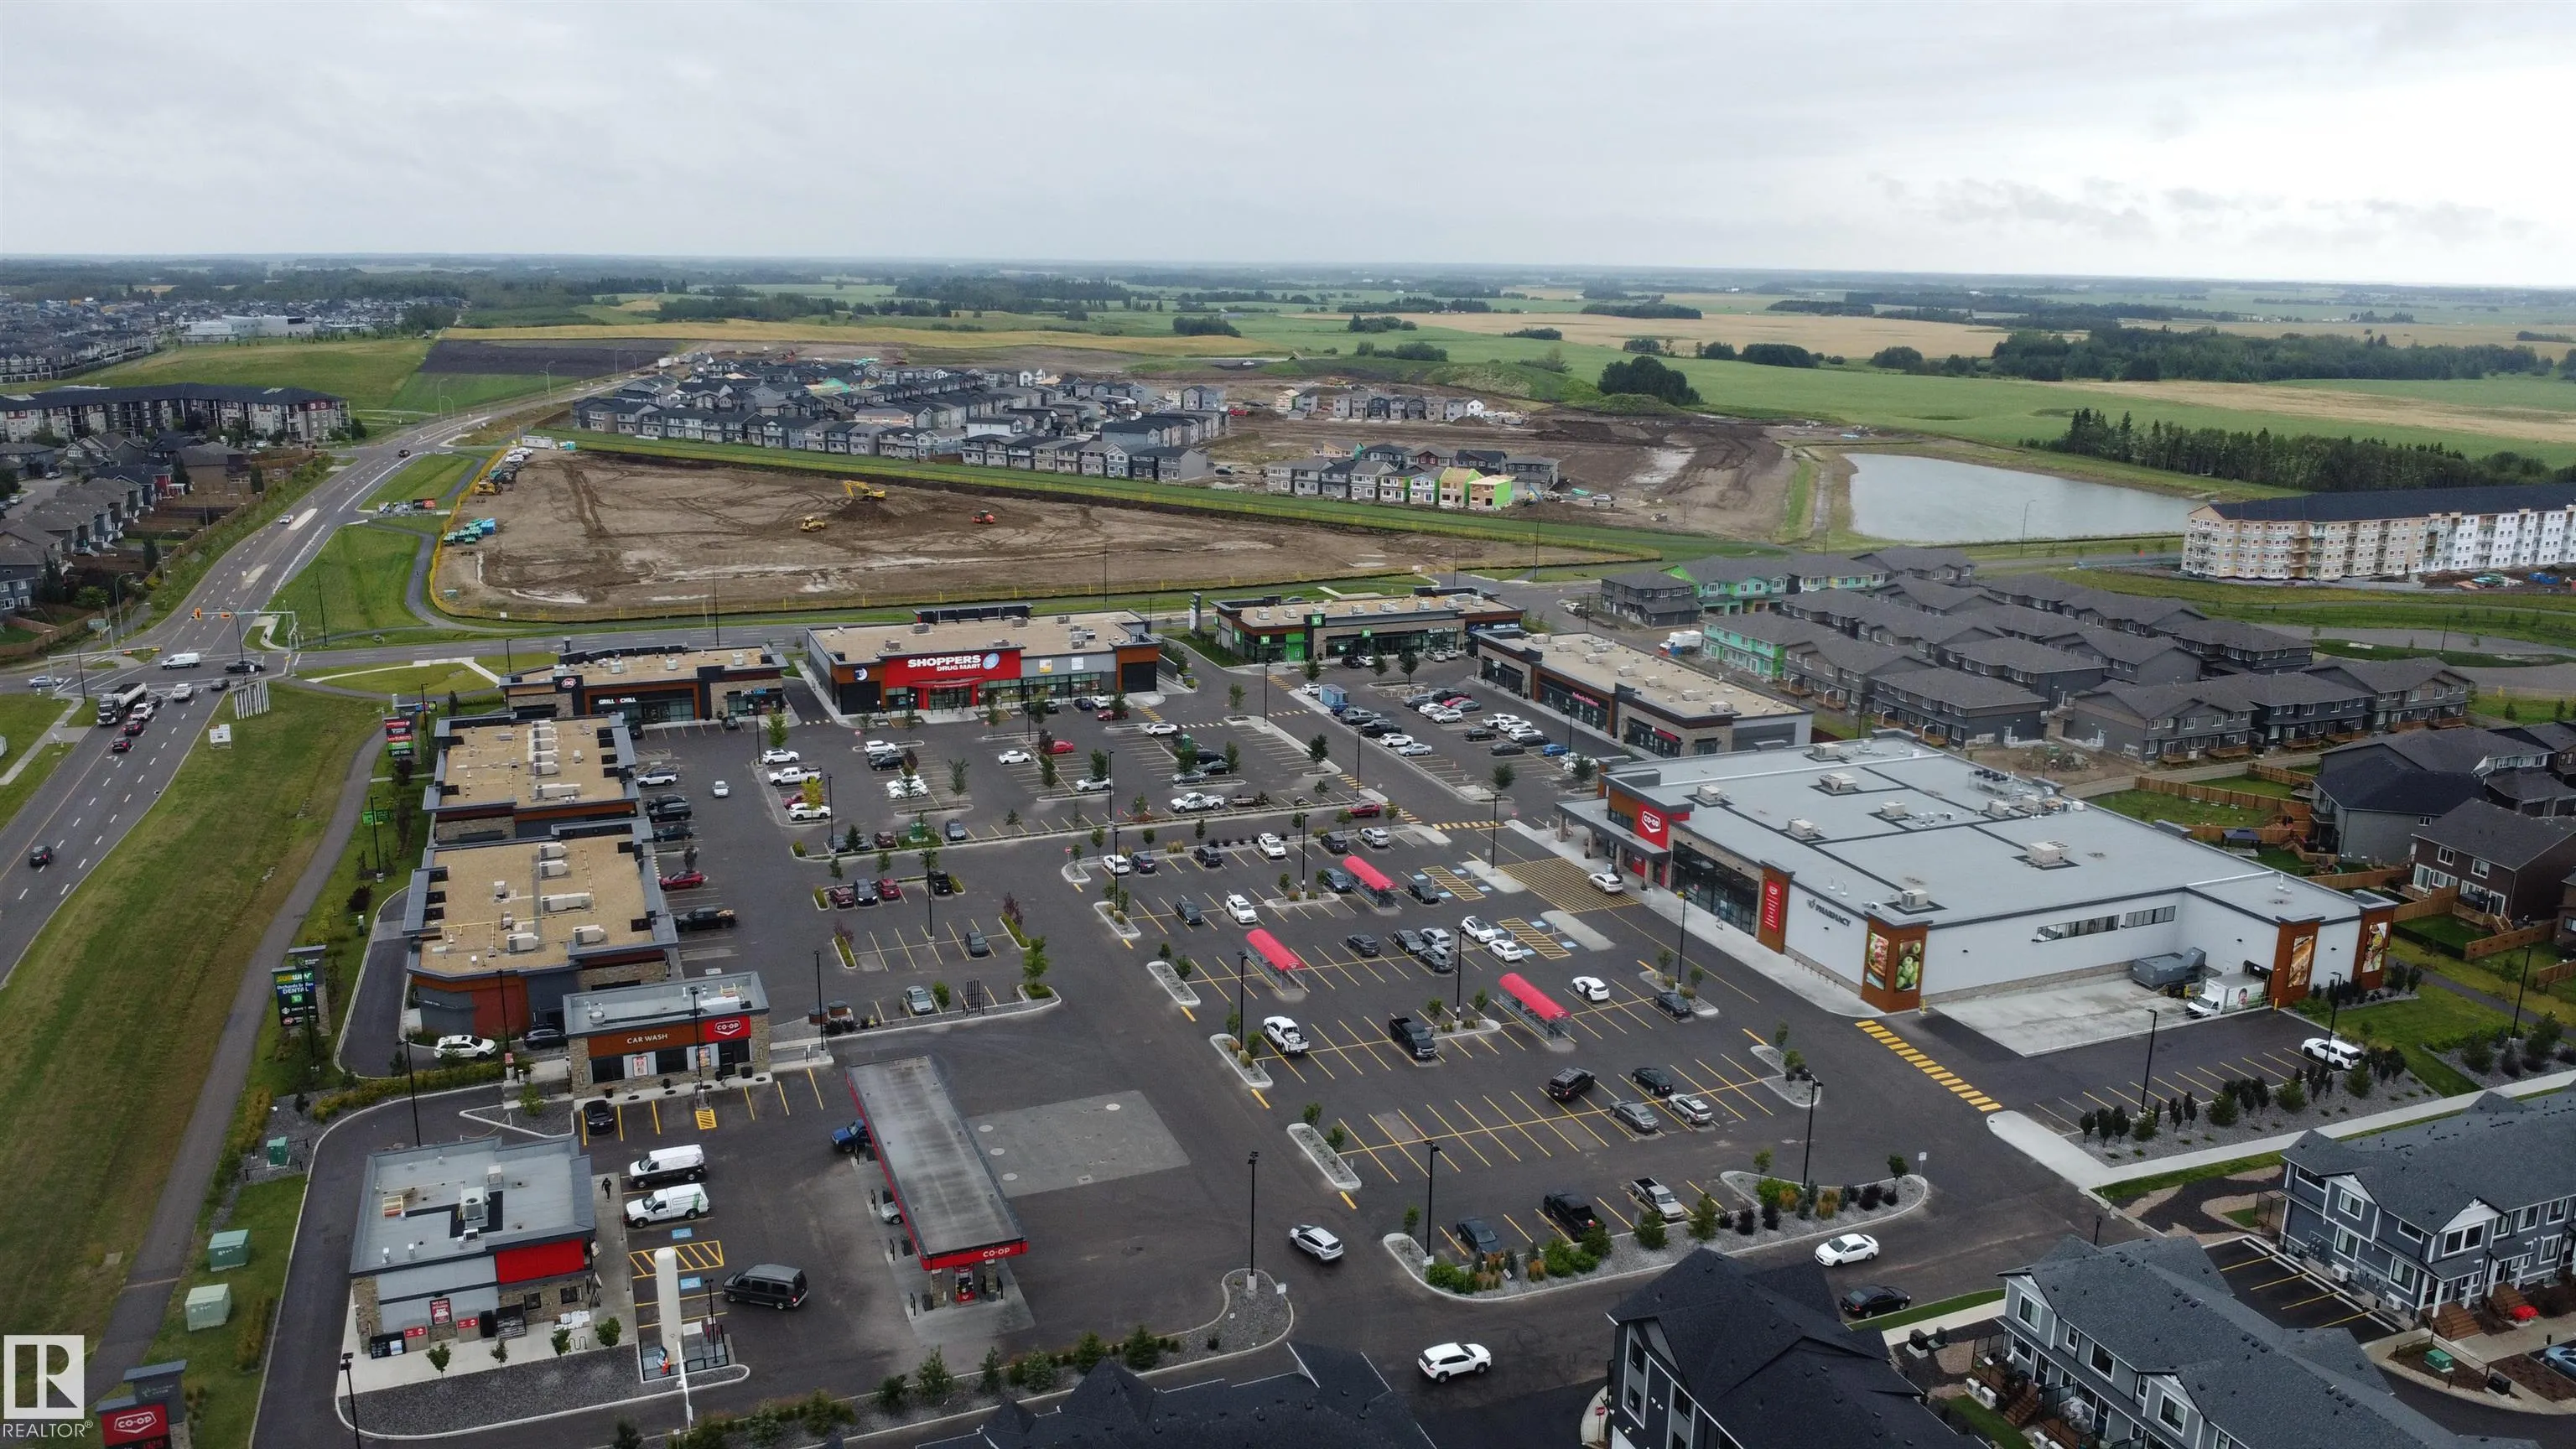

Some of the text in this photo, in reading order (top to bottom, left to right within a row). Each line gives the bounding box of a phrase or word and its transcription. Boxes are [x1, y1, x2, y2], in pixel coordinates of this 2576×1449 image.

[907, 655, 981, 667] SHOPPERS
[1644, 814, 1659, 828] CO-OP
[717, 1021, 740, 1031] CO-OP
[644, 1033, 668, 1042] WASH
[117, 1415, 152, 1429] CO-OP
